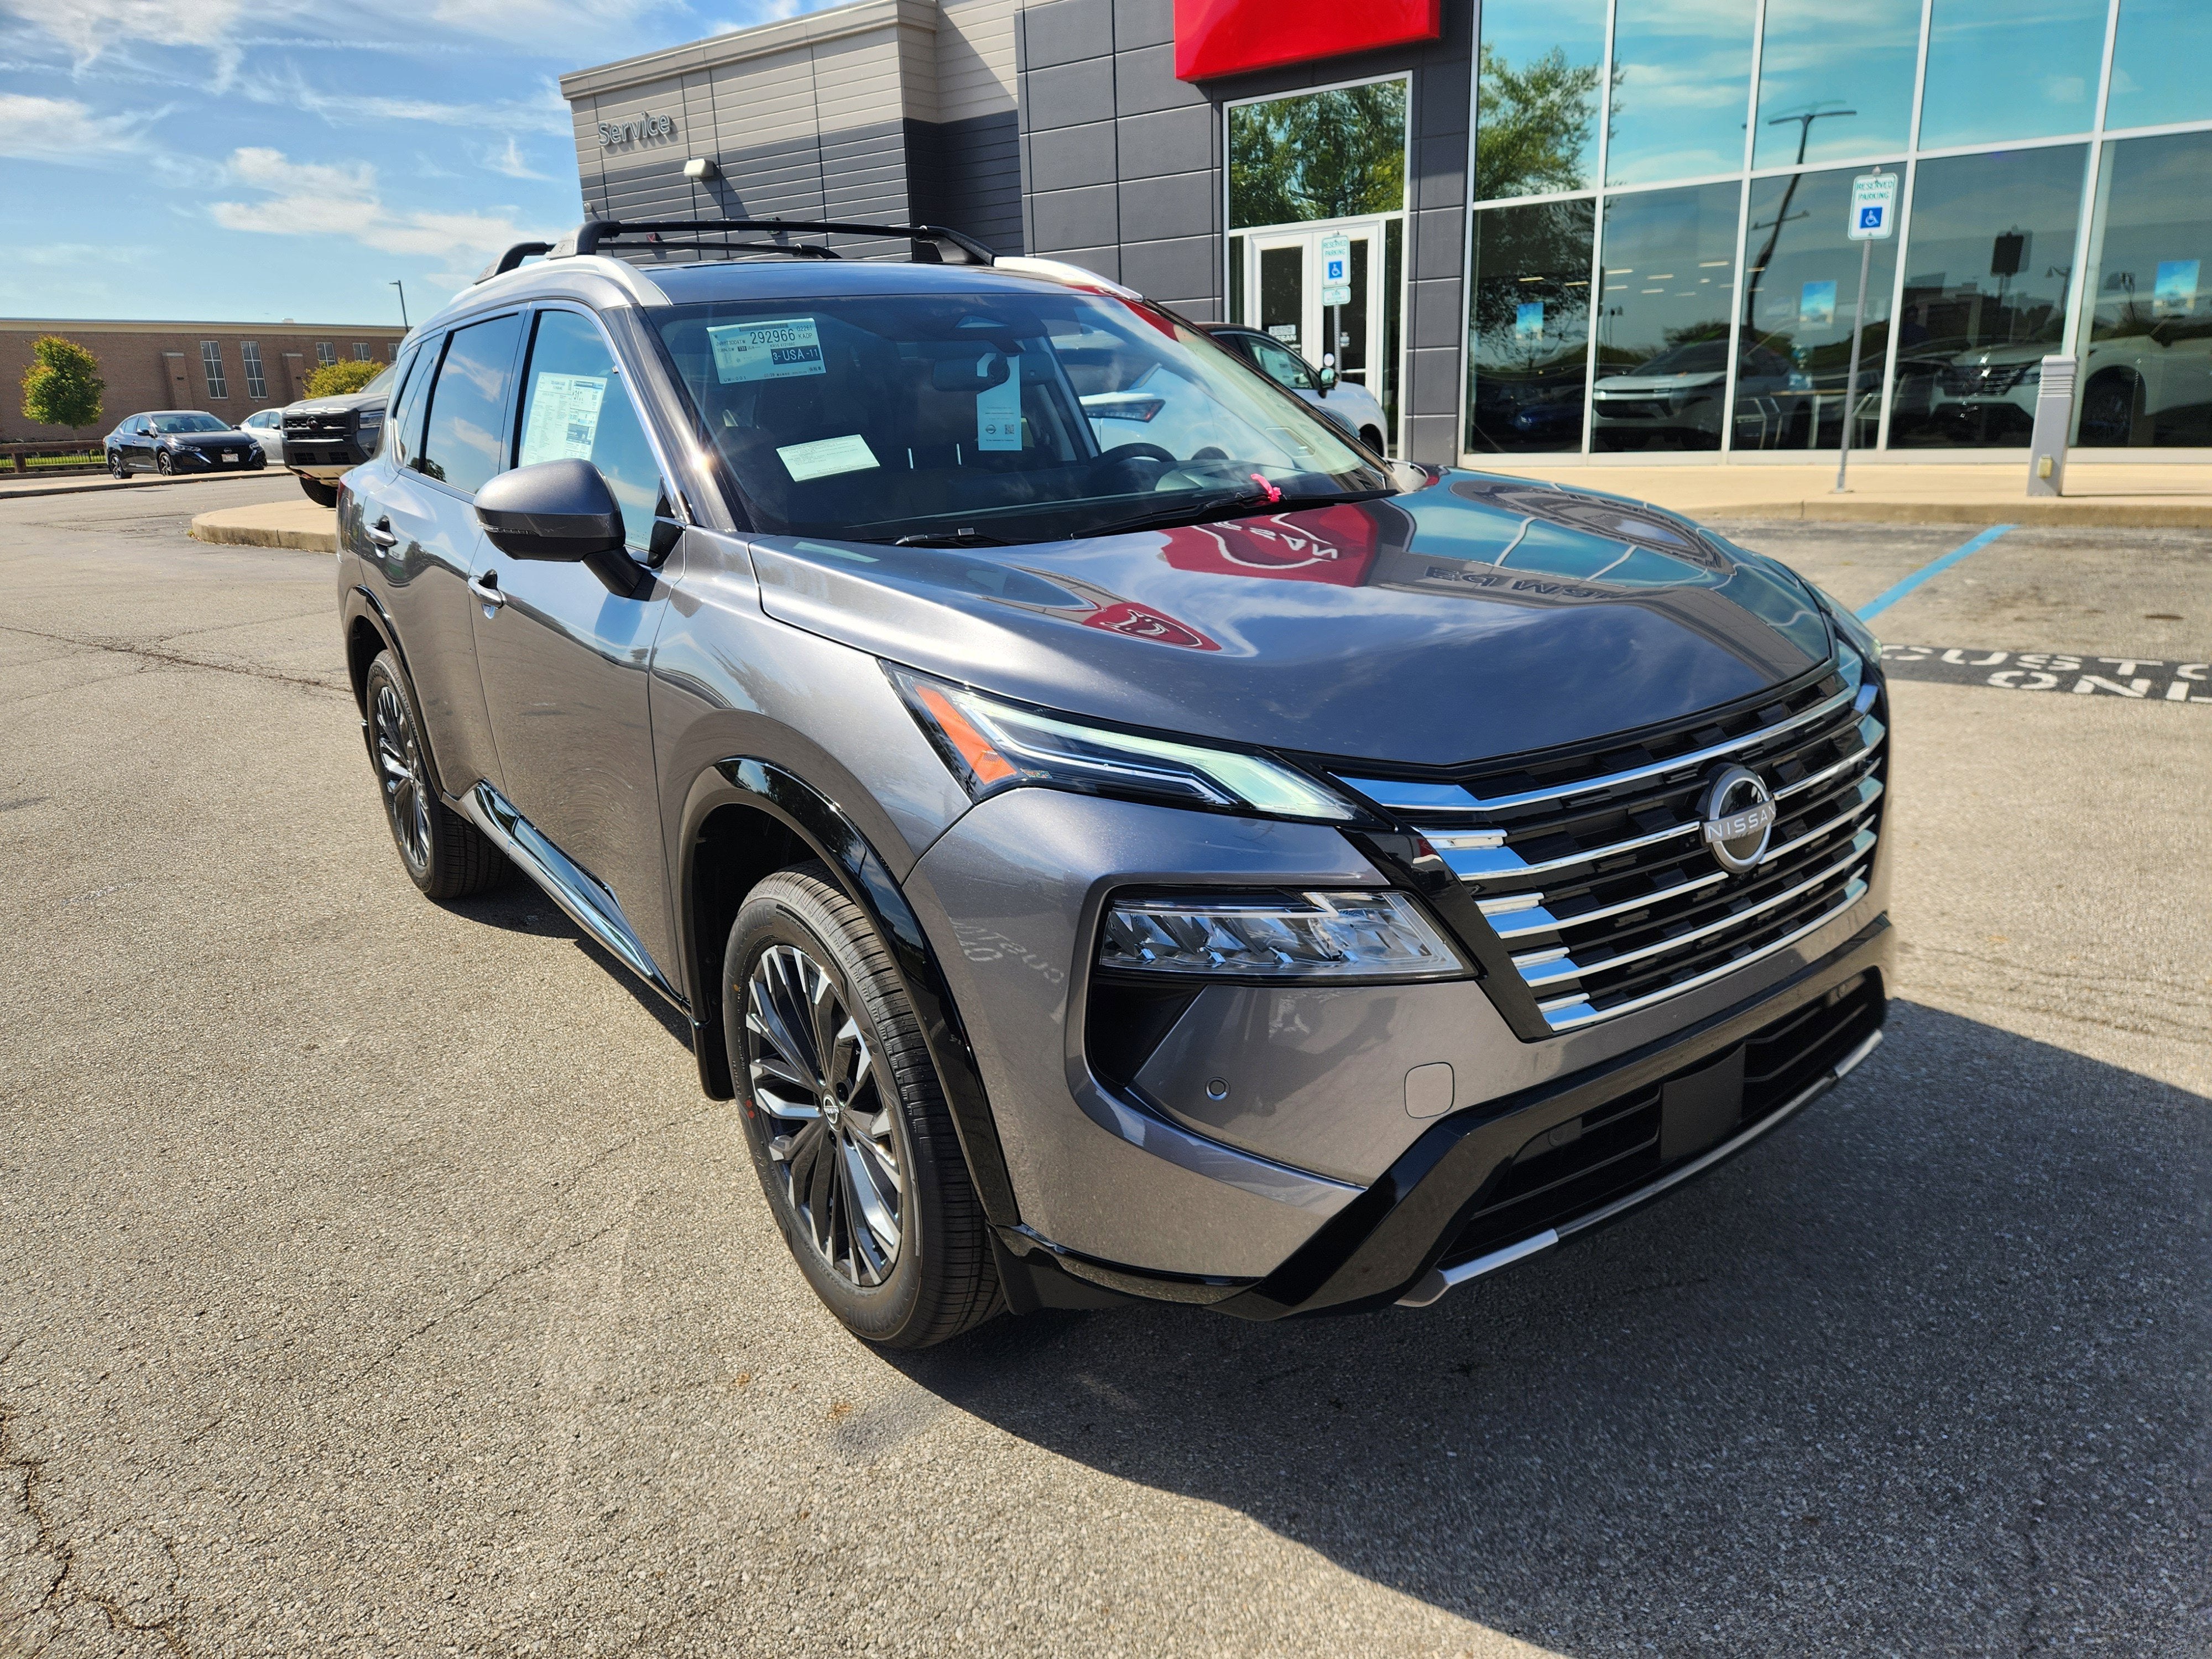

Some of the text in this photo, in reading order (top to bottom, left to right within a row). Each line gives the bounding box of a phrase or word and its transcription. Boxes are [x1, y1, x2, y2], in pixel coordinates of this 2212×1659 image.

[598, 111, 670, 145] Service
[1856, 181, 1895, 189] RESERVED
[1858, 191, 1888, 200] PARKING
[750, 328, 795, 344] 292966
[1707, 805, 1775, 839] NISSAN
